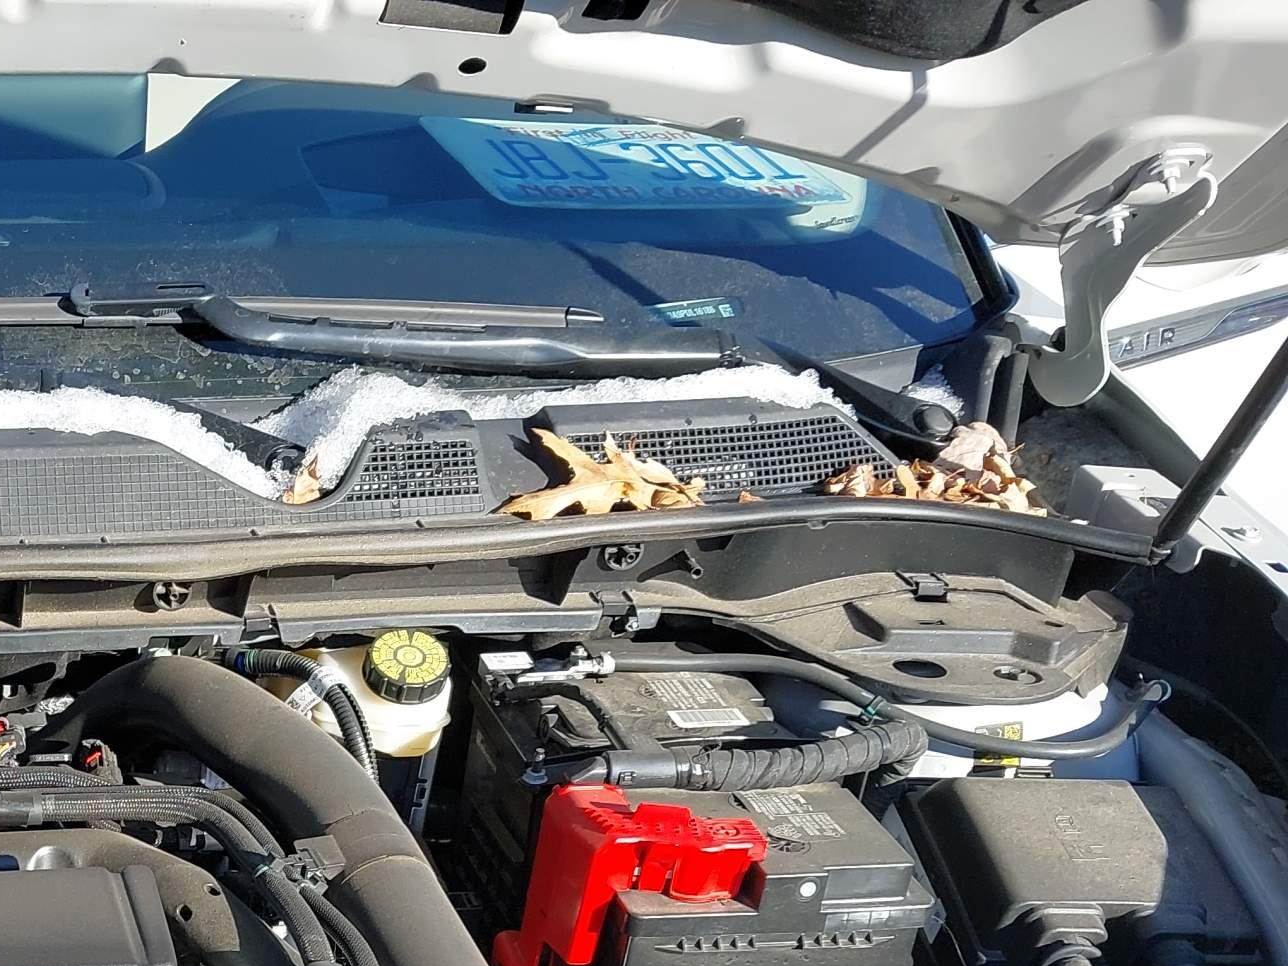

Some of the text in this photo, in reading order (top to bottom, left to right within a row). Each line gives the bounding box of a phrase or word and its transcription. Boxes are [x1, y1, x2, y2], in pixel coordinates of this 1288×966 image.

[619, 127, 699, 143] Flight
[485, 138, 809, 181] JBJ-3601
[517, 184, 635, 200] NORTH
[1118, 327, 1176, 358] AIR
